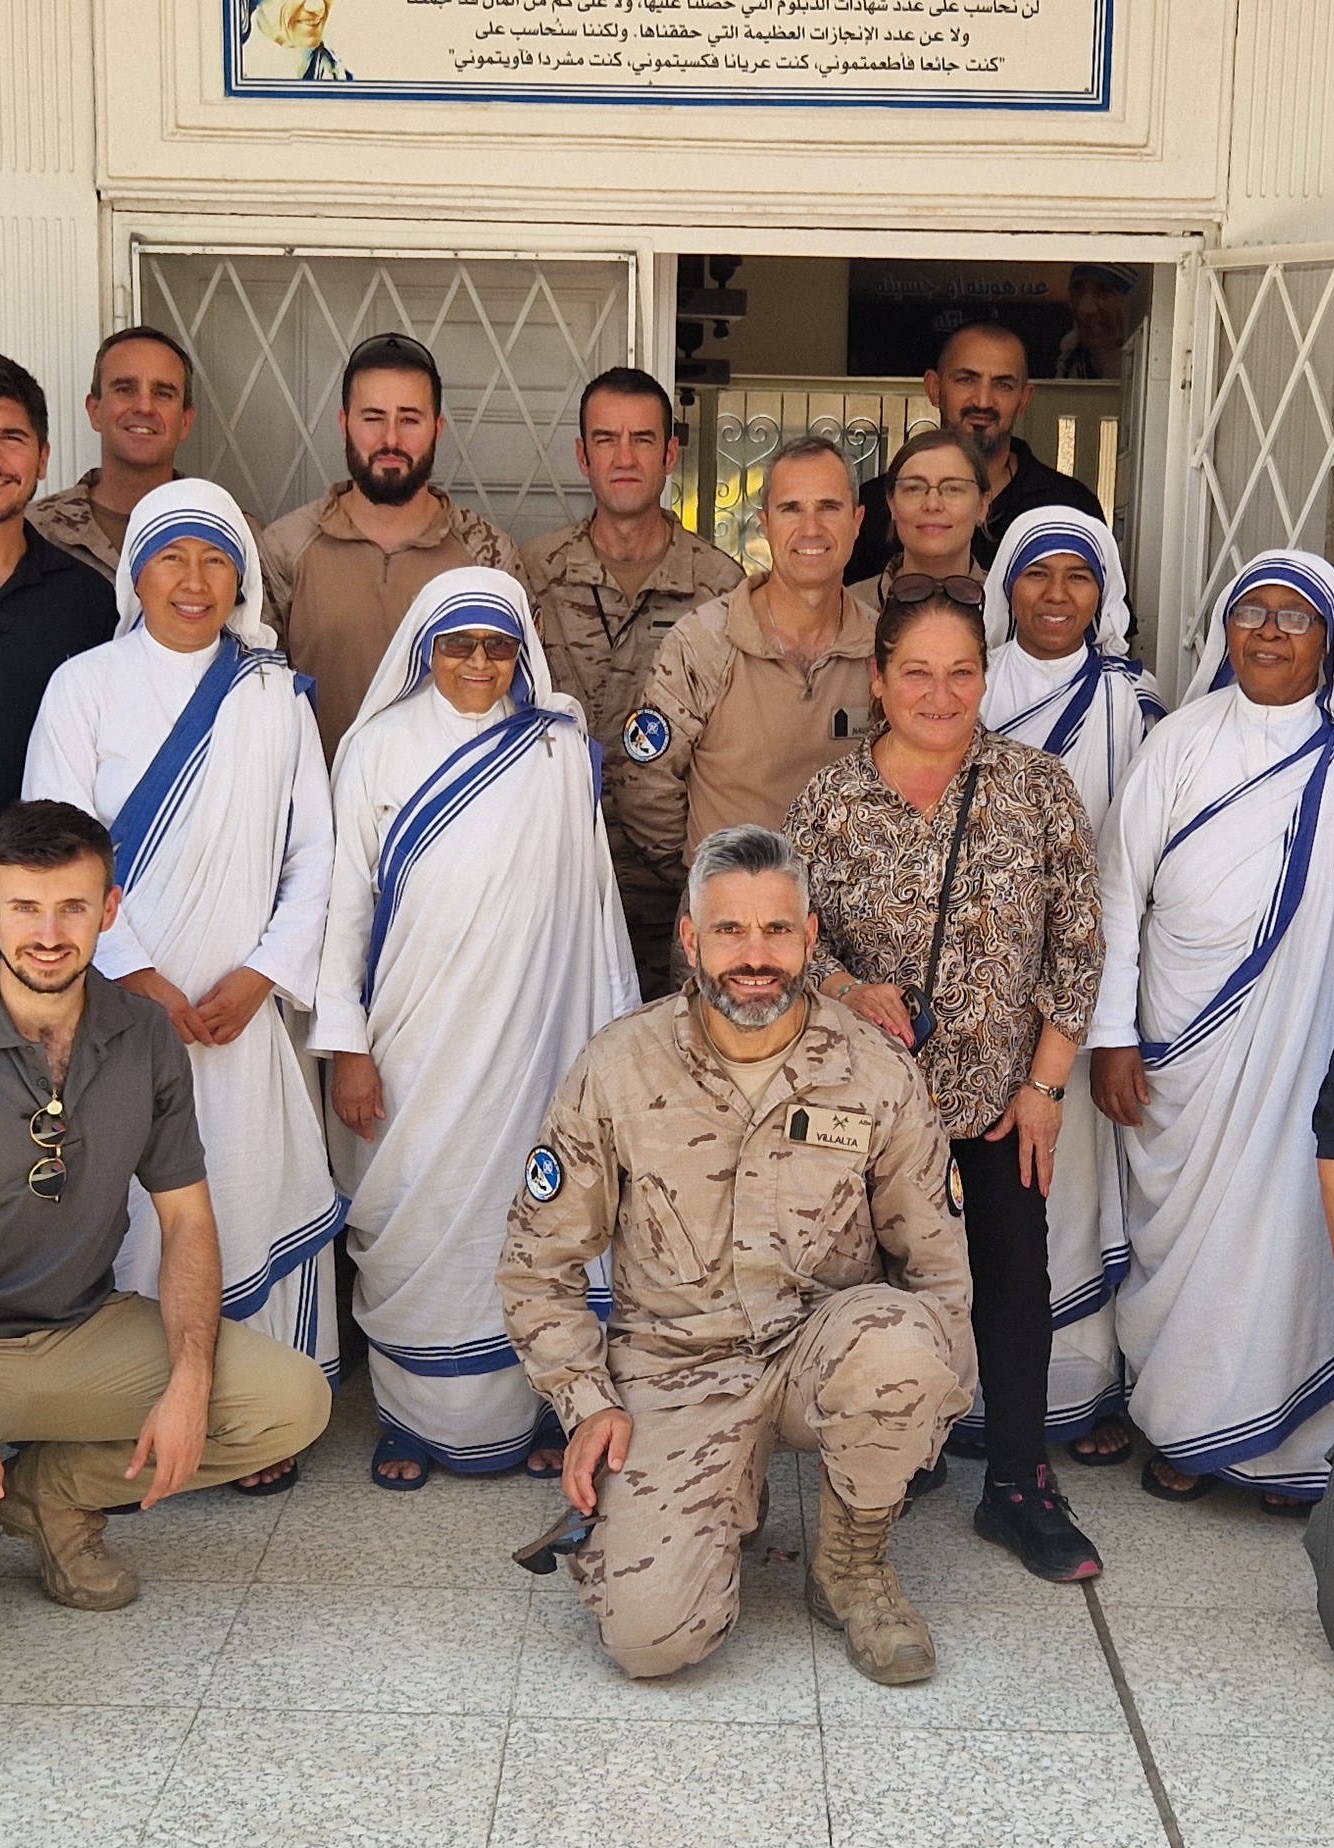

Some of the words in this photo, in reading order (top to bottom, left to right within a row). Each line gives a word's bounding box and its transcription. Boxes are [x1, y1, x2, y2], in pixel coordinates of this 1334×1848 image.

[892, 0, 925, 12] عدد
[928, 0, 960, 18] على
[475, 20, 506, 40] على
[582, 22, 629, 43] ولكننا
[707, 24, 739, 48] التي
[743, 24, 806, 45] العظيمة
[883, 29, 916, 42] عدد
[919, 30, 945, 47] عن
[949, 26, 970, 48] ولا
[537, 50, 585, 71] مشردا
[588, 51, 623, 67] كنت
[724, 53, 772, 74] عريانا
[775, 53, 810, 70] كنت
[920, 56, 961, 76] جائعا
[816, 1131, 859, 1148] VILLALTA
